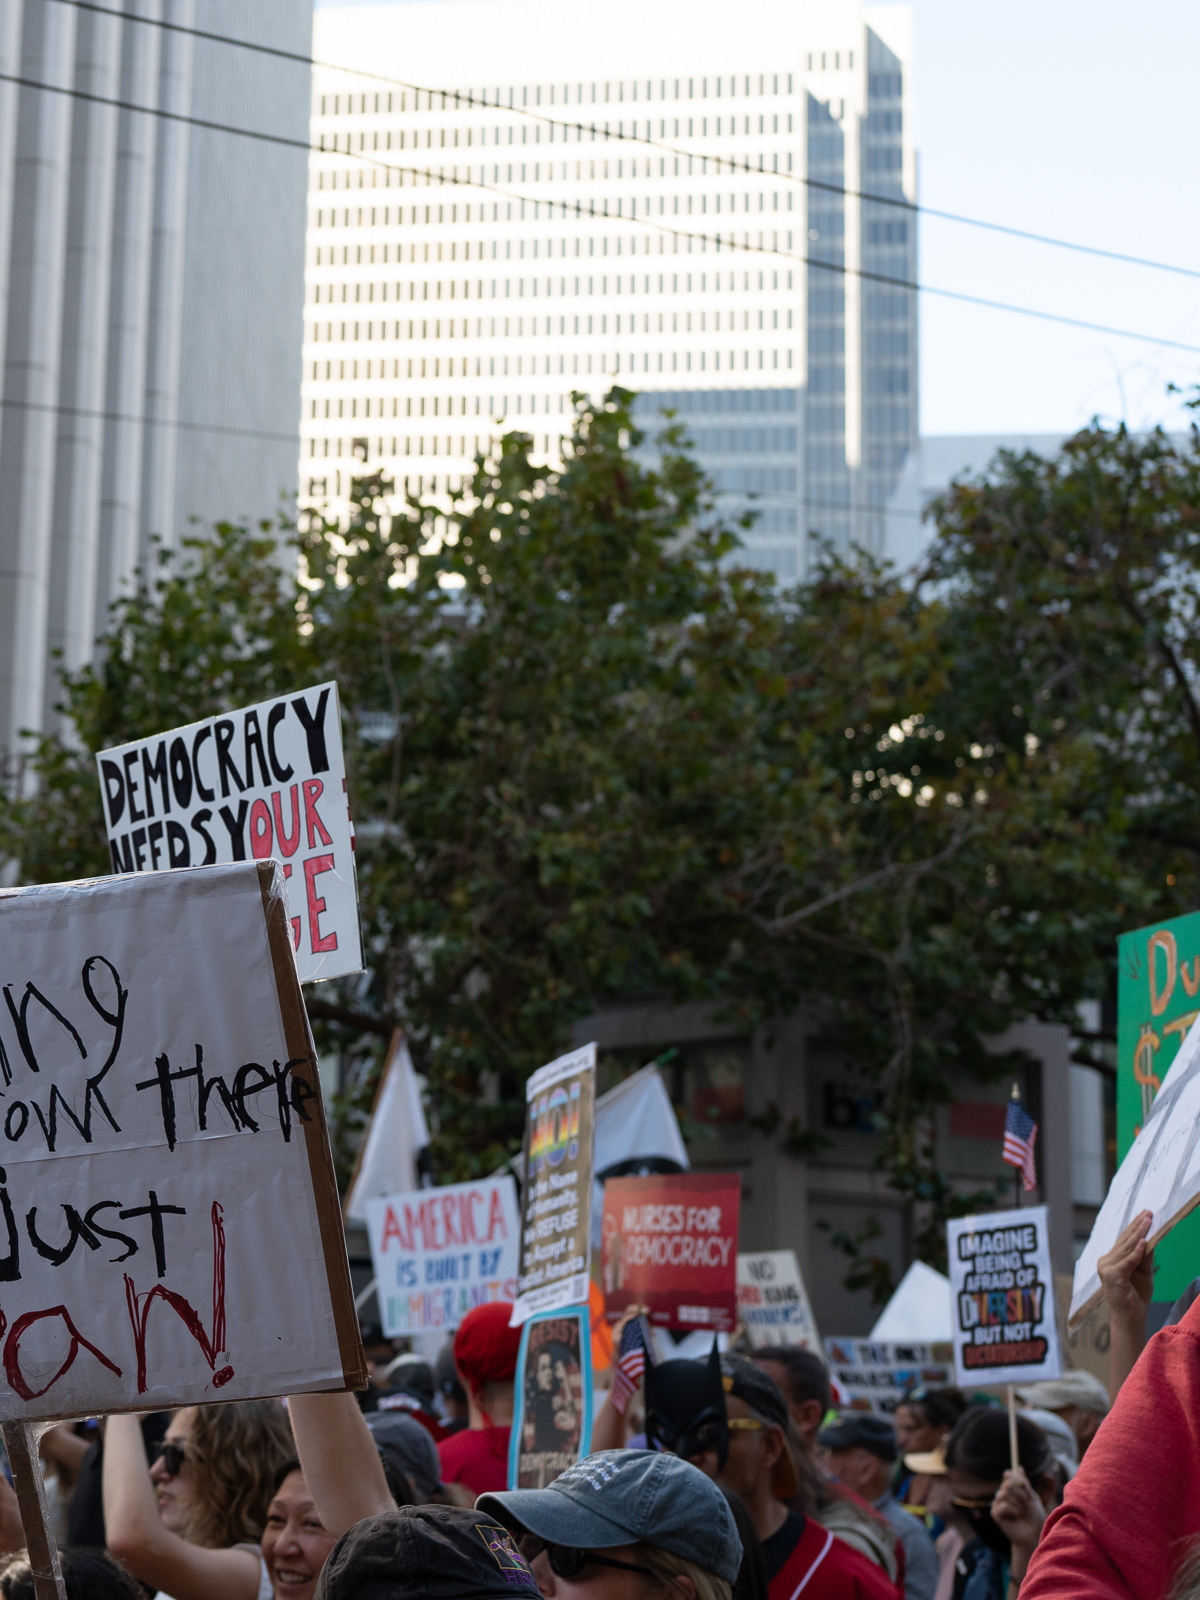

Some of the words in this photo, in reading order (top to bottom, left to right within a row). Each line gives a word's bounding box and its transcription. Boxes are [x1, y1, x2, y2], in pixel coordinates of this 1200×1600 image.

[100, 687, 331, 828] DEMOCRACY
[218, 778, 333, 861] YOUR
[380, 1187, 509, 1254] AMERICA
[535, 1207, 579, 1240] REFUSE
[622, 1204, 685, 1233] NURSES
[685, 1205, 722, 1233] FOR
[624, 1234, 734, 1268] DEMOCRACY
[959, 1226, 1036, 1260] IMAGINE
[397, 1258, 418, 1288] IS
[424, 1252, 473, 1285] BUILT
[478, 1245, 503, 1278] BY
[544, 1254, 585, 1280] America
[973, 1251, 1023, 1274] BEING
[966, 1270, 1015, 1293] AFRAID
[1014, 1267, 1036, 1288] OF
[959, 1285, 1044, 1329] DIVERSITY
[973, 1325, 1002, 1346] BUT
[1003, 1322, 1032, 1343] NOT
